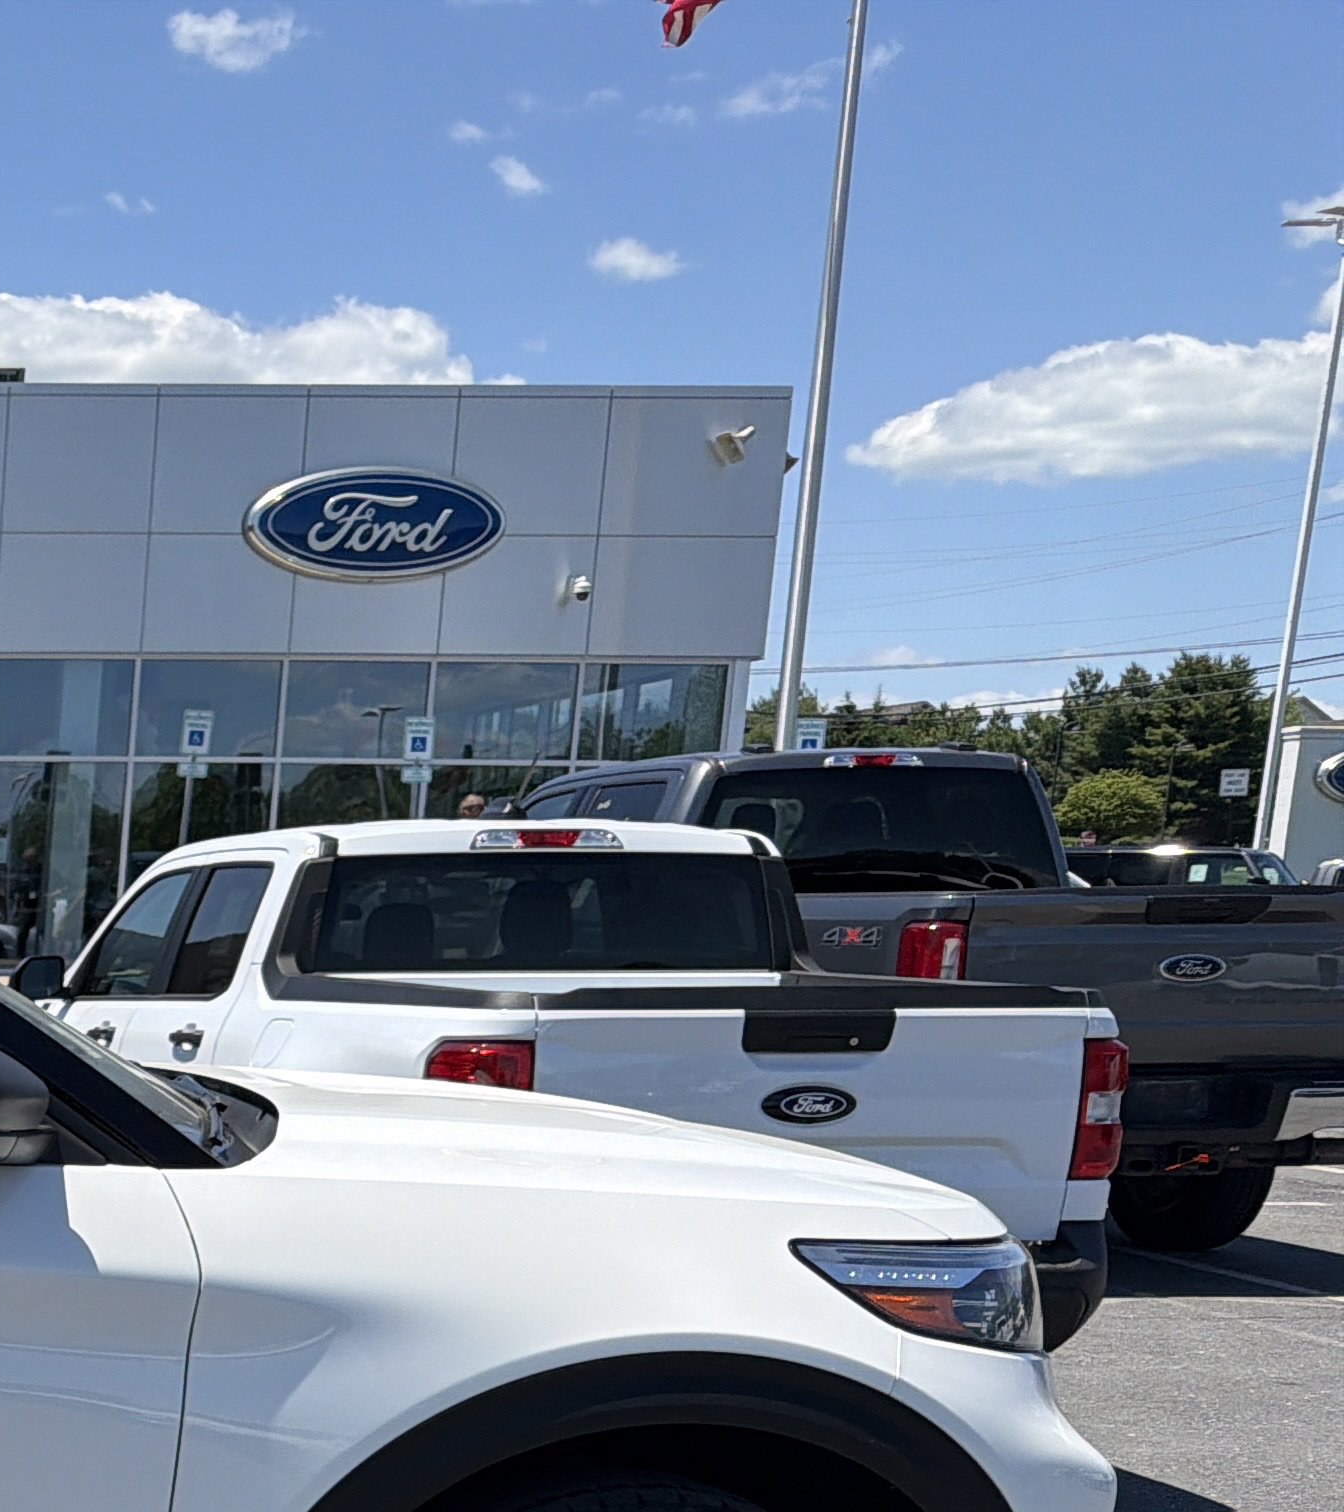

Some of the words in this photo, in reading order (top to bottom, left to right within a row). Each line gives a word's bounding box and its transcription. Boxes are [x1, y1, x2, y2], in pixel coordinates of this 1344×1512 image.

[307, 492, 454, 552] Ford
[1175, 959, 1213, 975] Ford
[793, 1095, 835, 1113] Ford
